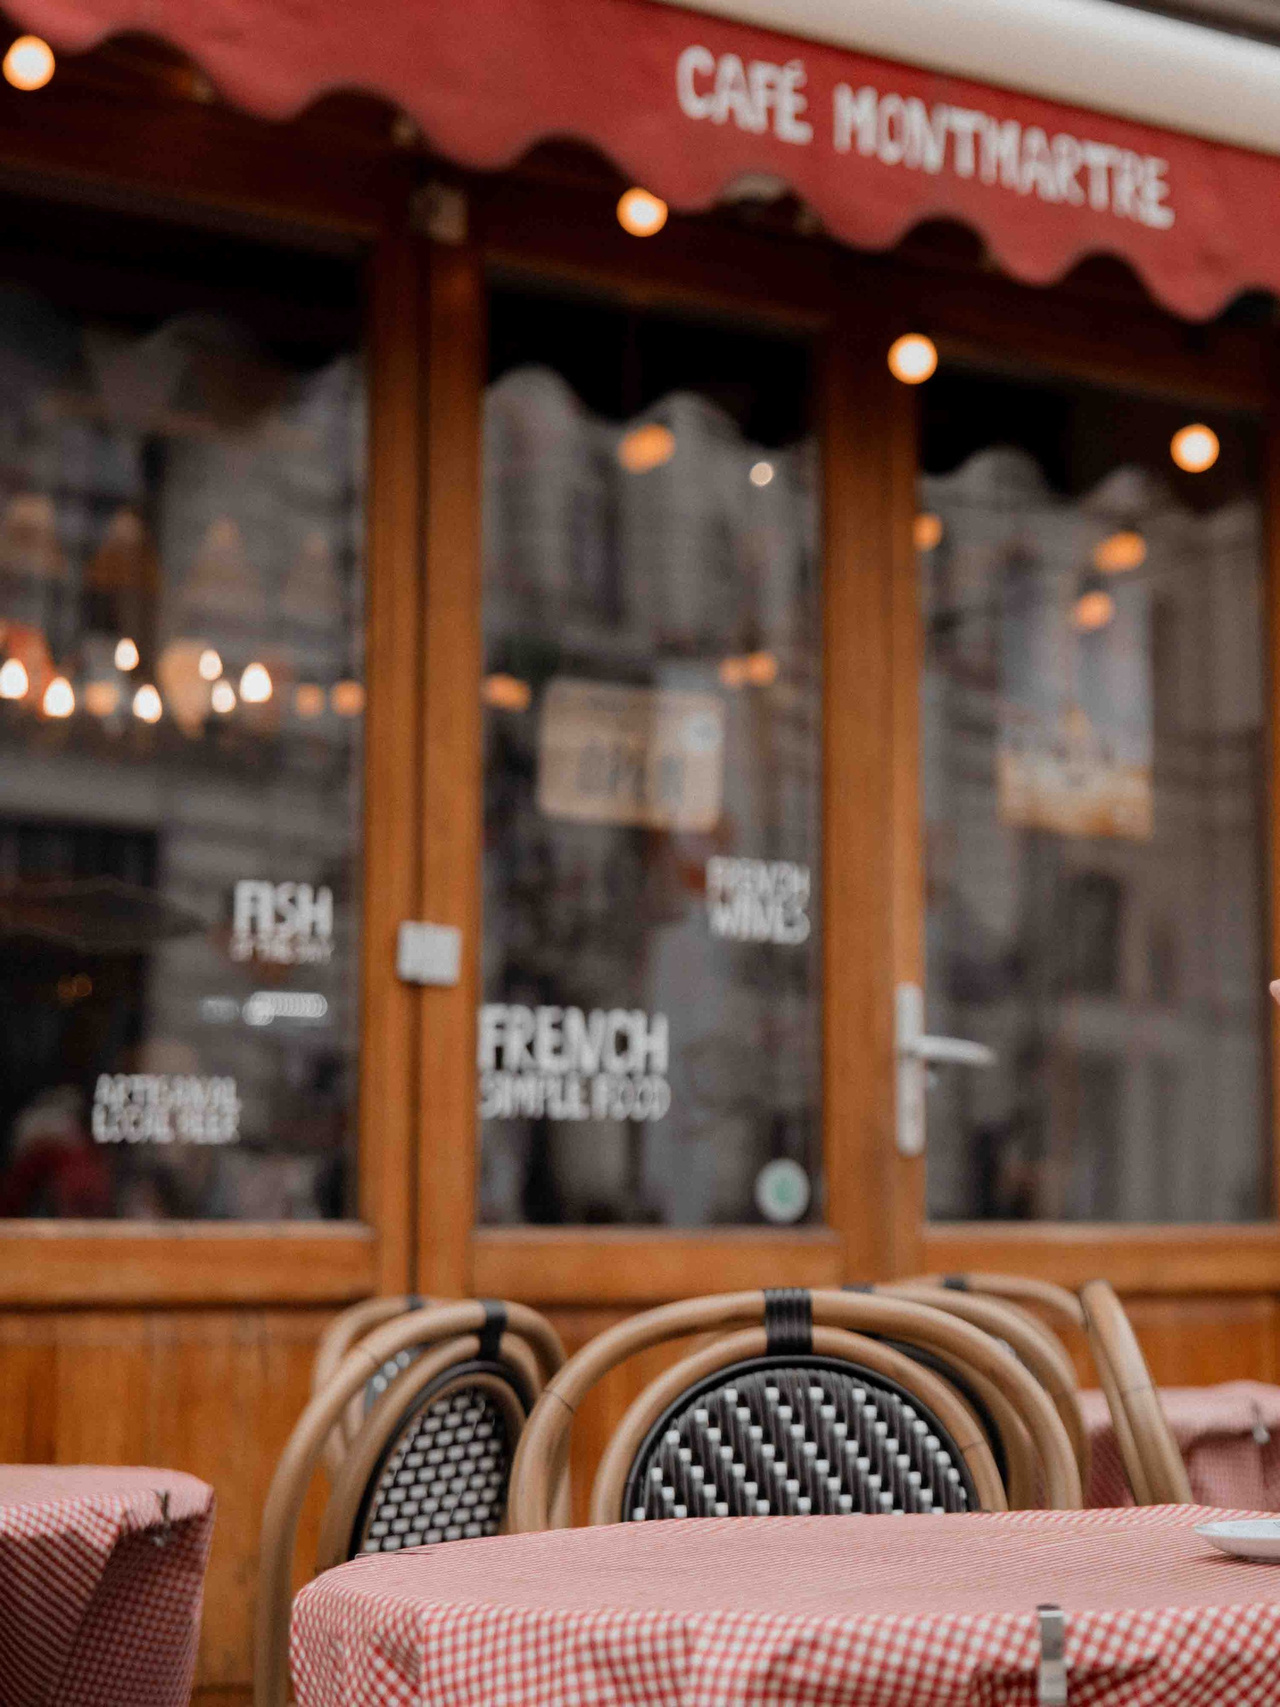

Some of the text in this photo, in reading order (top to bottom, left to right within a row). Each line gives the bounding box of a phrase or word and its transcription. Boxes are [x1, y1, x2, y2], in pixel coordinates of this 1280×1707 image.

[676, 45, 1175, 230] CAFÉ MONTMARTRE
[232, 878, 334, 939] FISH
[478, 1002, 670, 1076] FRENCH
